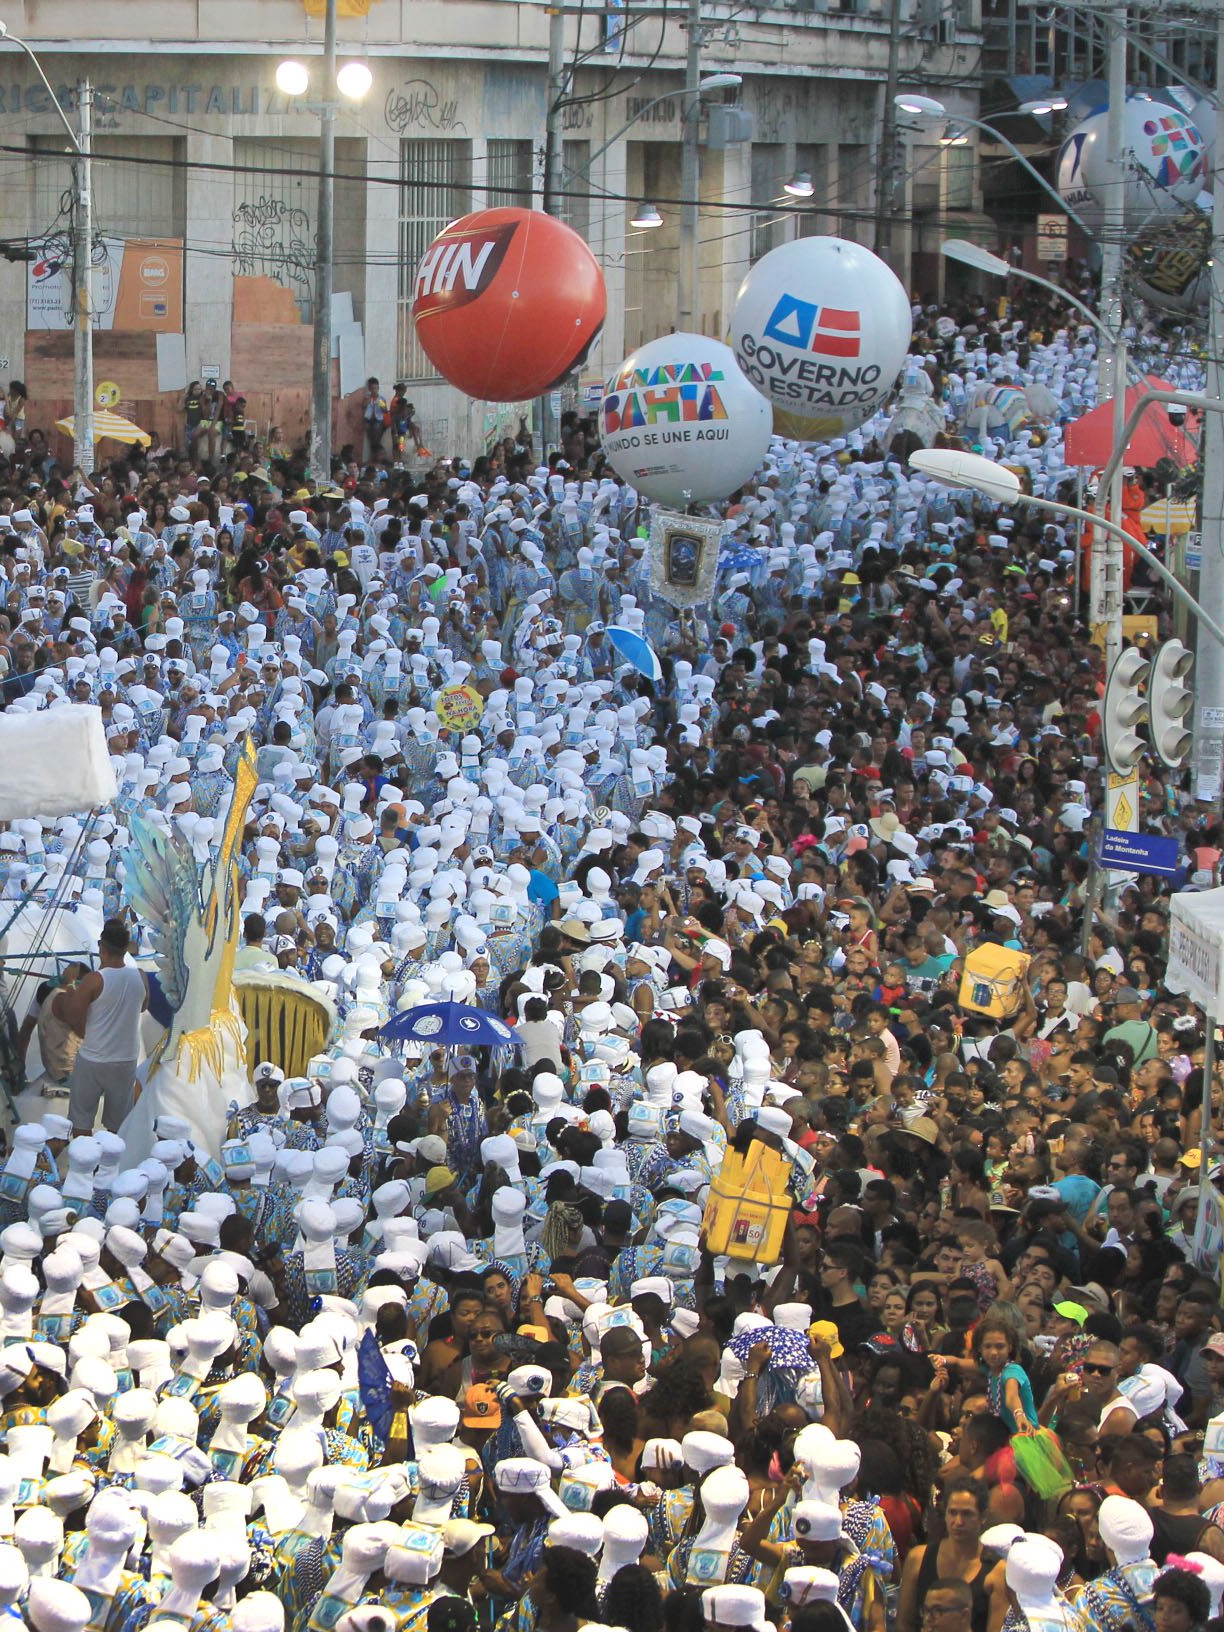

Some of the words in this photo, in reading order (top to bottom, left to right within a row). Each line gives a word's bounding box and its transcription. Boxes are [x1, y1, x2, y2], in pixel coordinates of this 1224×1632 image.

[741, 333, 881, 388] GOVERNO
[736, 351, 765, 385] DO
[769, 377, 879, 406] ESTADO
[604, 384, 729, 435] BAHIA
[644, 432, 658, 445] SE
[662, 430, 691, 444] UNE
[696, 428, 729, 441] AQUI
[1105, 843, 1114, 851] da
[1115, 845, 1149, 857] Montanha
[1106, 834, 1129, 845] Ladeira
